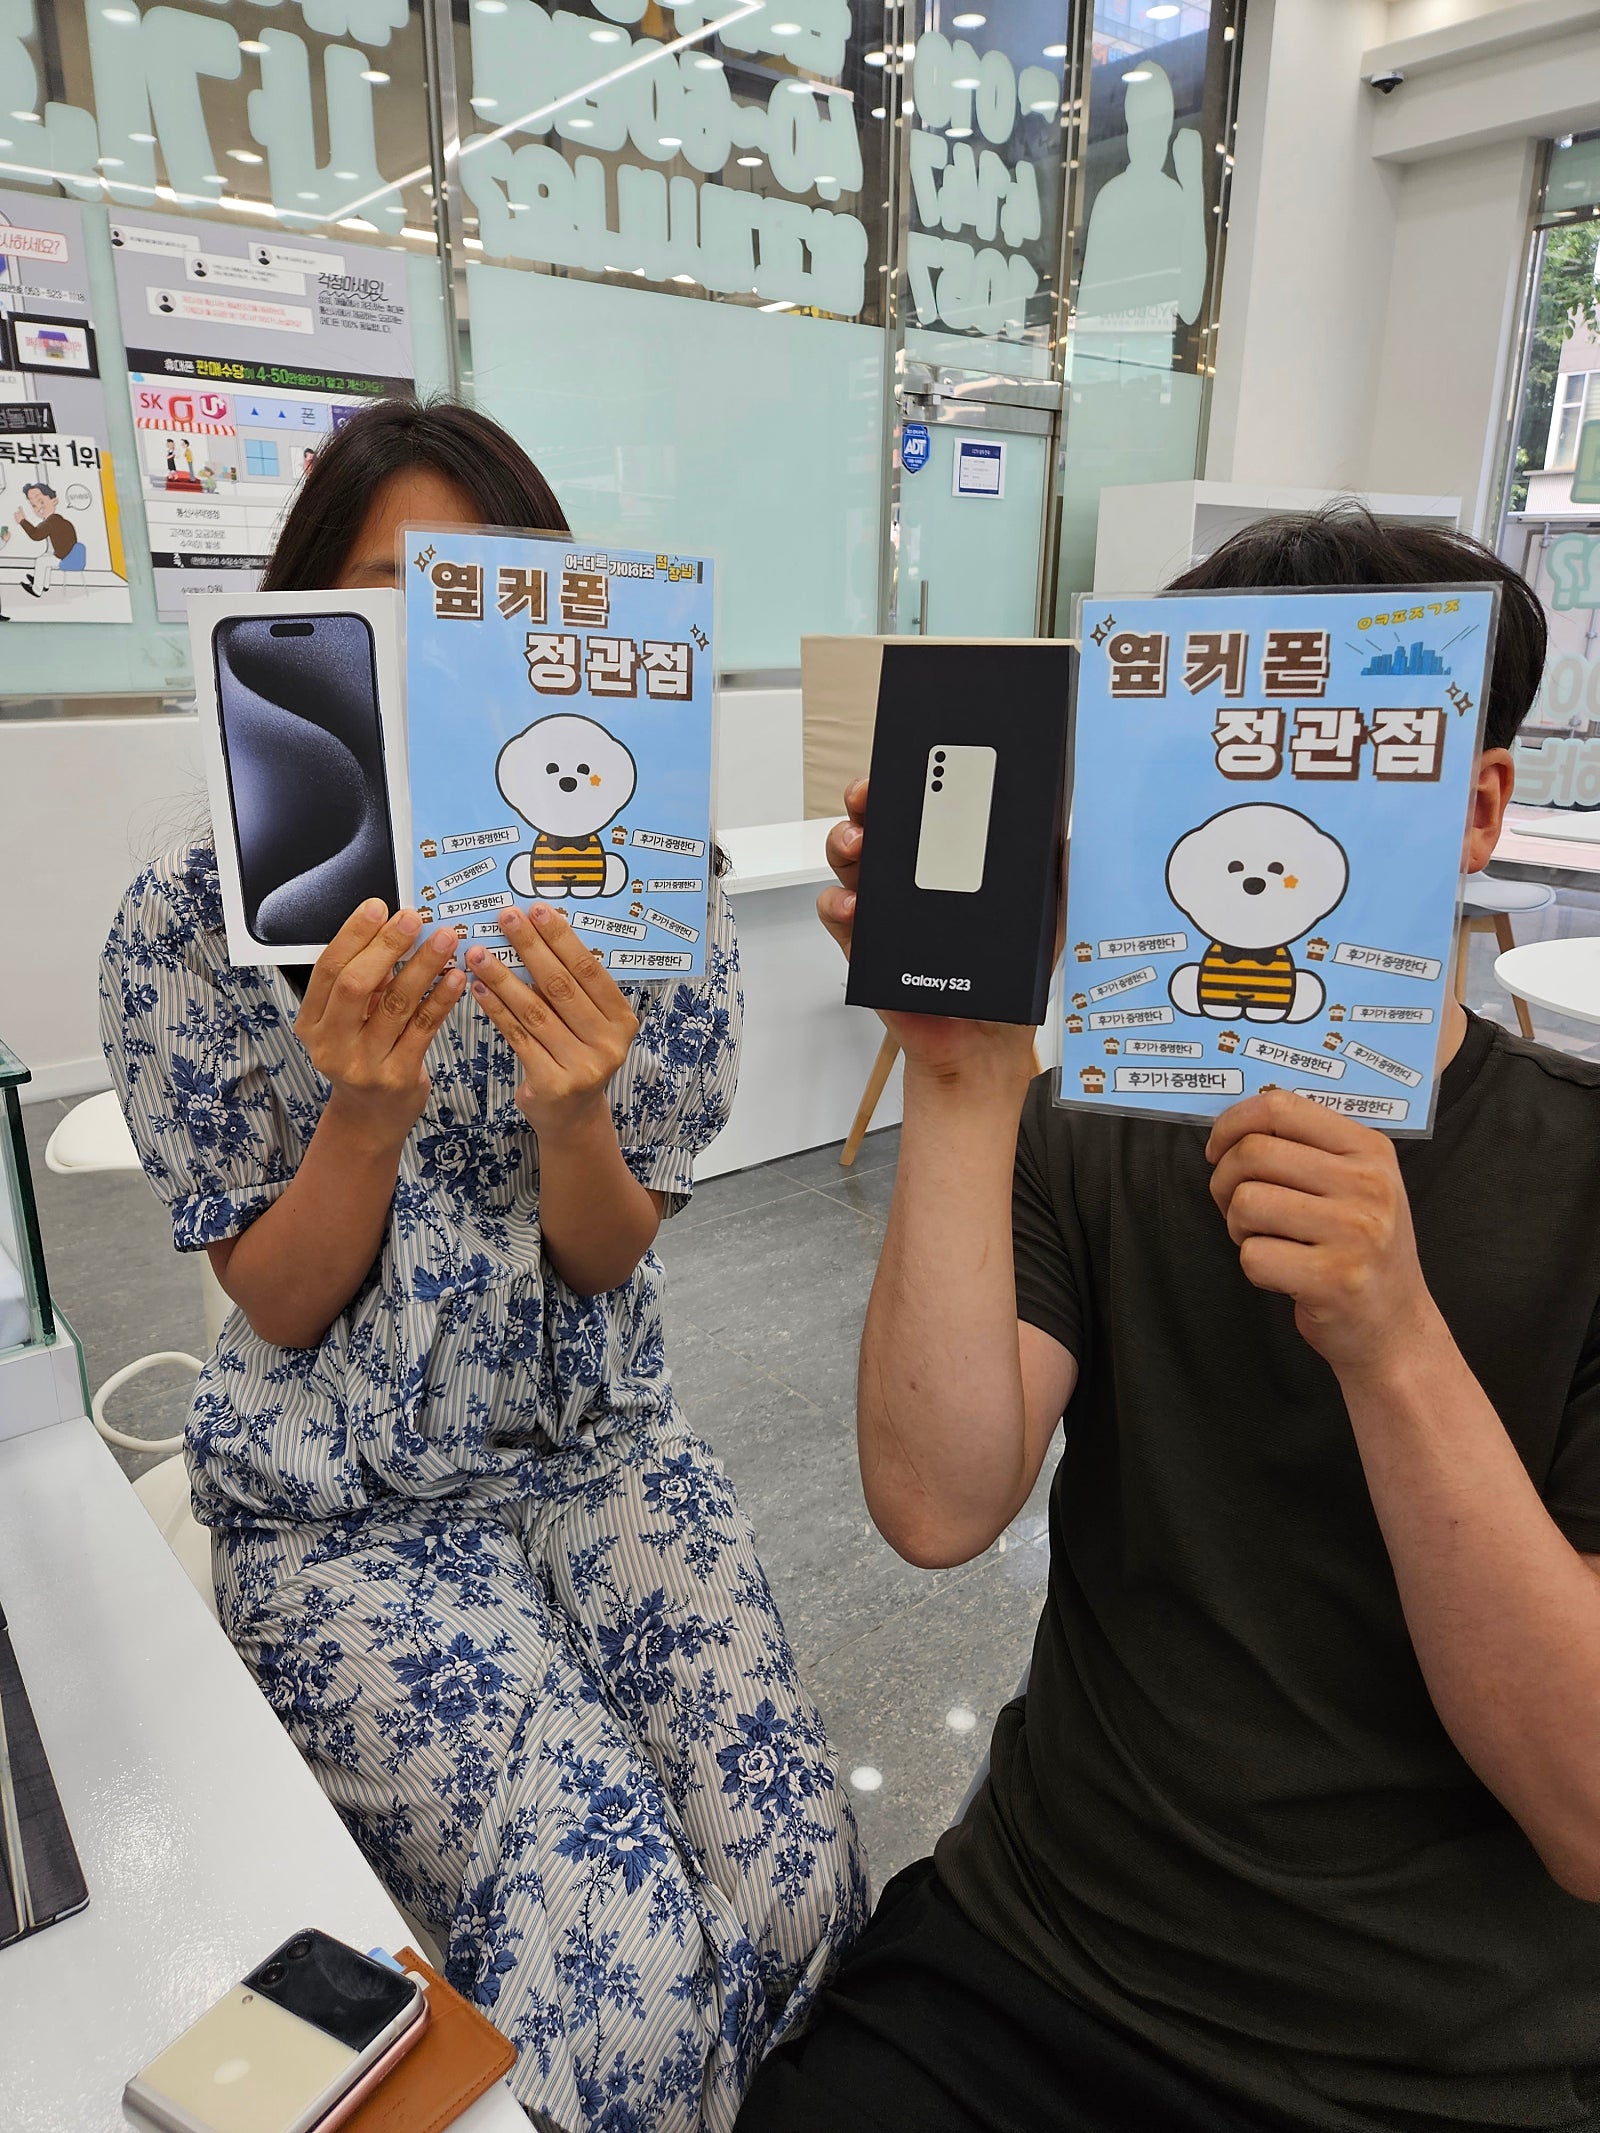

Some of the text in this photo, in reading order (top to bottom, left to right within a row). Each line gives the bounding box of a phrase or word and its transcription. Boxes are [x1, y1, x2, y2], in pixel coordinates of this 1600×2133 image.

[141, 392, 163, 410] SK
[301, 406, 316, 425] 폰
[66, 439, 101, 470] 1위
[903, 438, 927, 457] ADT
[609, 561, 655, 579] 가야하죠
[656, 554, 694, 582] 점장님
[524, 632, 693, 701] 정관점
[1212, 706, 1447, 781] 정관점
[451, 830, 510, 849] 후기가 증명한다
[641, 834, 696, 853] 후기가 증명한다
[444, 862, 489, 887] 후기가 증명한다
[653, 880, 696, 889] 후기가 증명한다
[447, 895, 504, 915] 후기가 증명한다
[581, 916, 638, 935] 후기가 증명한다
[651, 912, 693, 937] 후기가 증명한다
[1107, 937, 1176, 954] 후기가 증명한다
[619, 953, 683, 967] 후기가 증명한다
[1346, 948, 1427, 974] 후기가 증명한다
[901, 973, 971, 991] Galaxy S23
[1097, 971, 1148, 996] 후기가 증명한다
[1098, 1010, 1163, 1026] 후기가 증명한다
[1360, 1008, 1423, 1020] 후기가 증명한다
[1132, 1042, 1193, 1054] 후기가 증명한다
[1256, 1044, 1332, 1073] 후기가 증명한다
[1352, 1047, 1412, 1080] 후기가 증명한다
[1128, 1072, 1226, 1089] 후기가 증명한다
[1343, 1098, 1394, 1115] 증명한다
